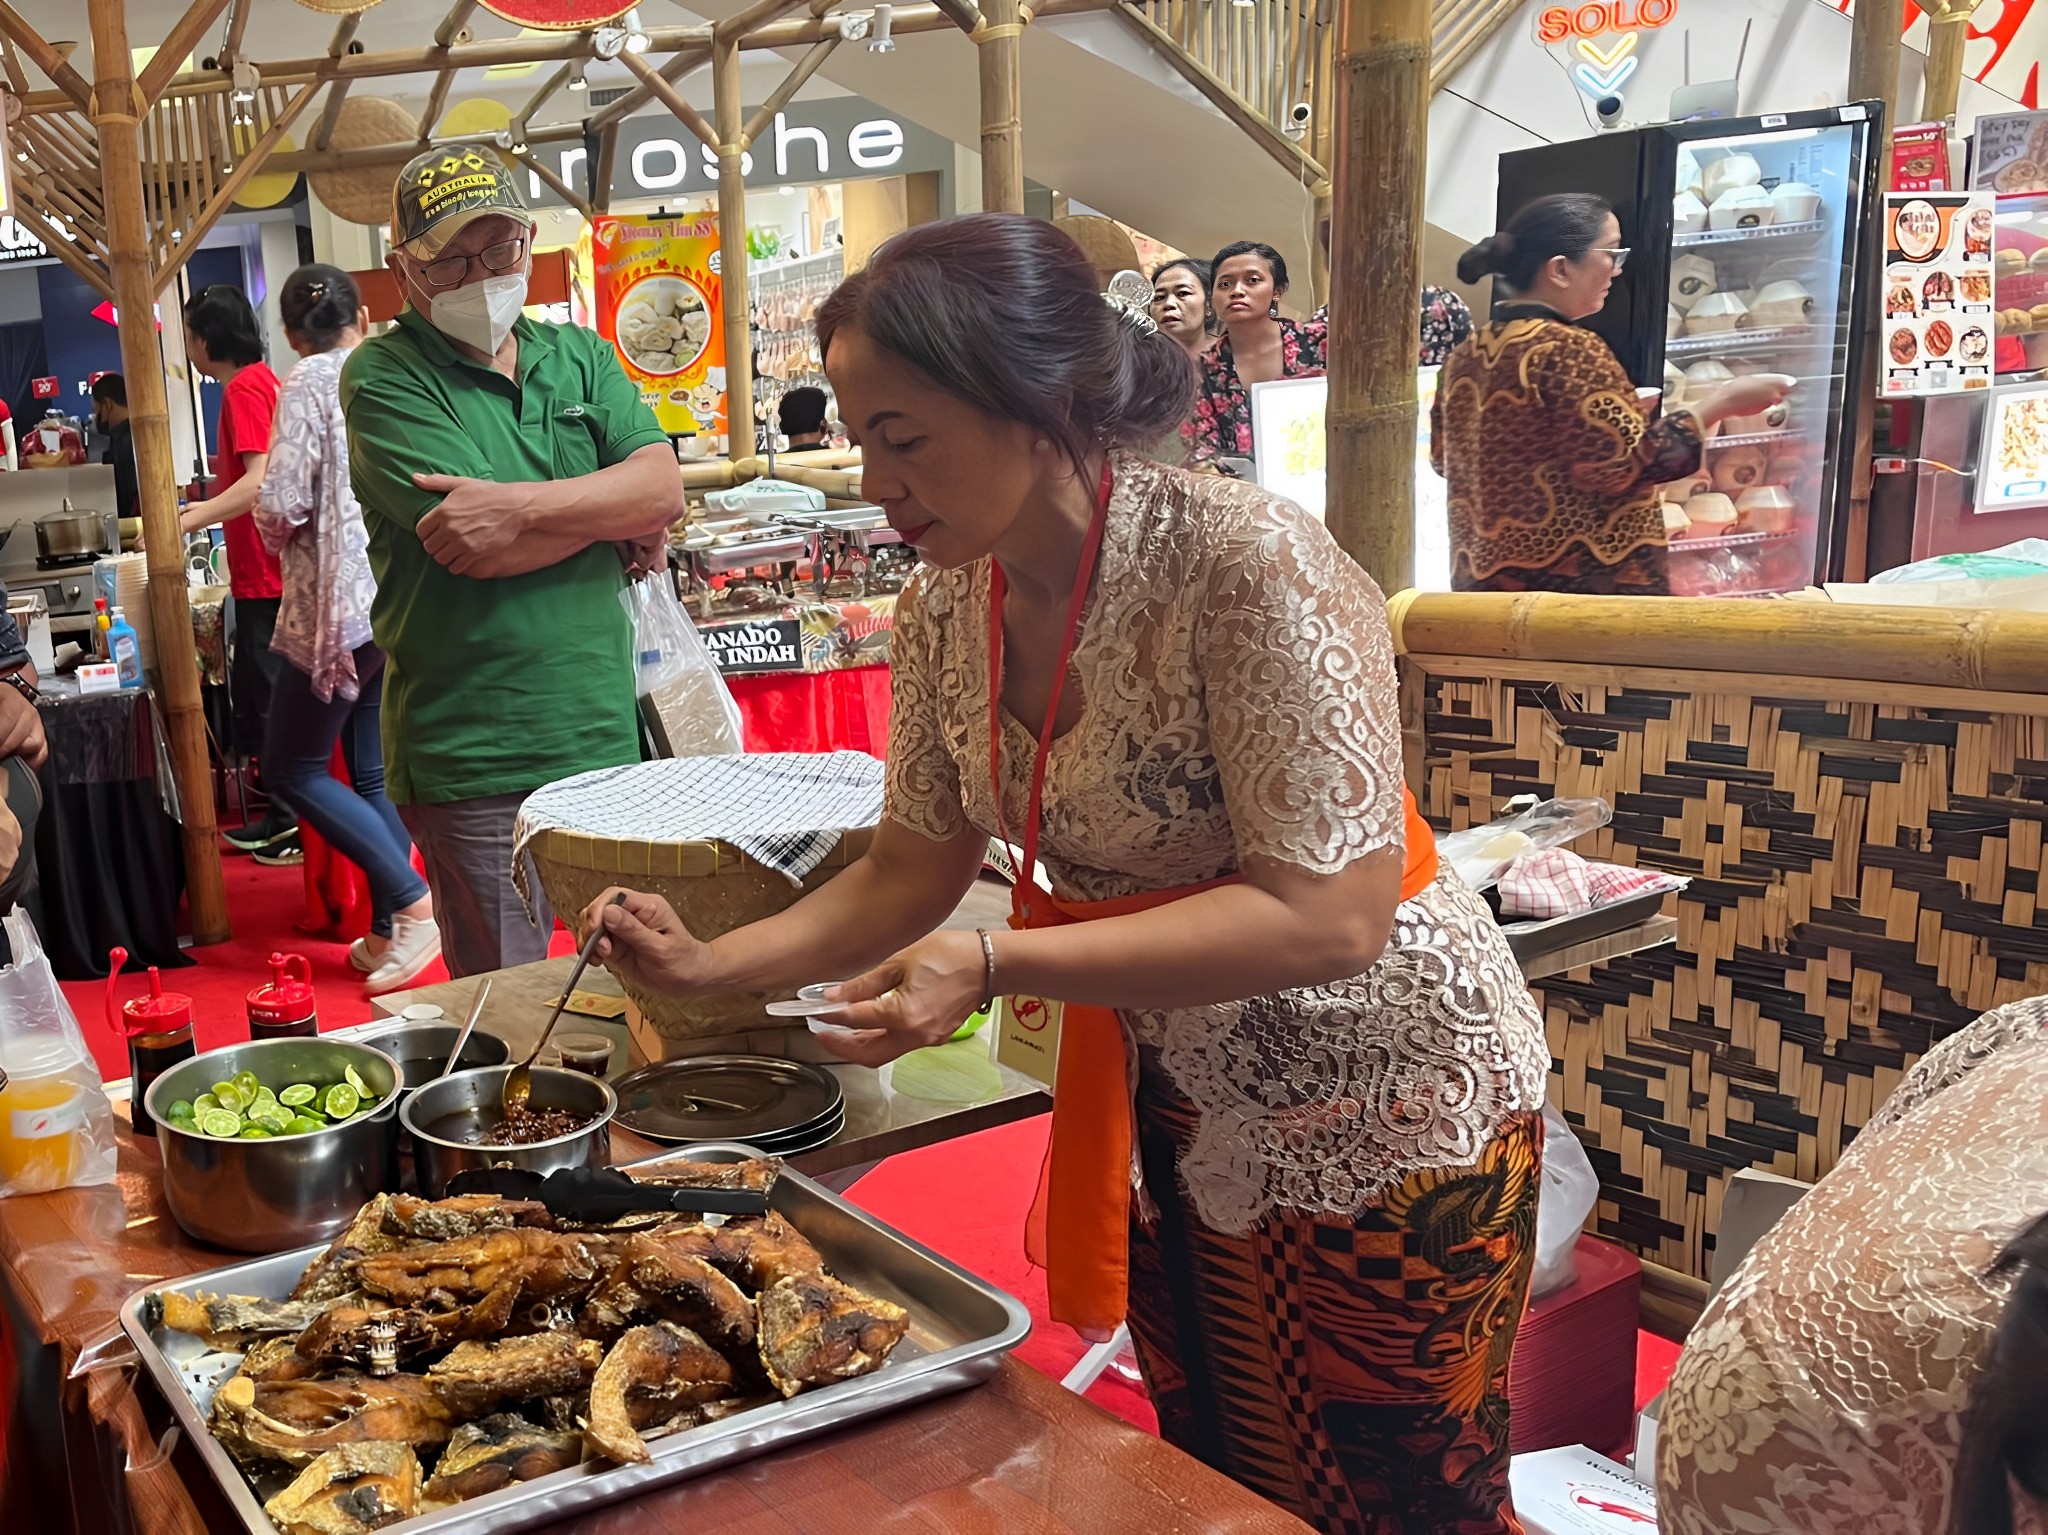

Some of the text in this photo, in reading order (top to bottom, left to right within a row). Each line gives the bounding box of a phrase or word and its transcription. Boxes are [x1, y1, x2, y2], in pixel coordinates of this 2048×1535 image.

[1538, 0, 1678, 43] SOLO
[427, 176, 488, 202] AUSTRALIA
[726, 645, 796, 665] INDAH
